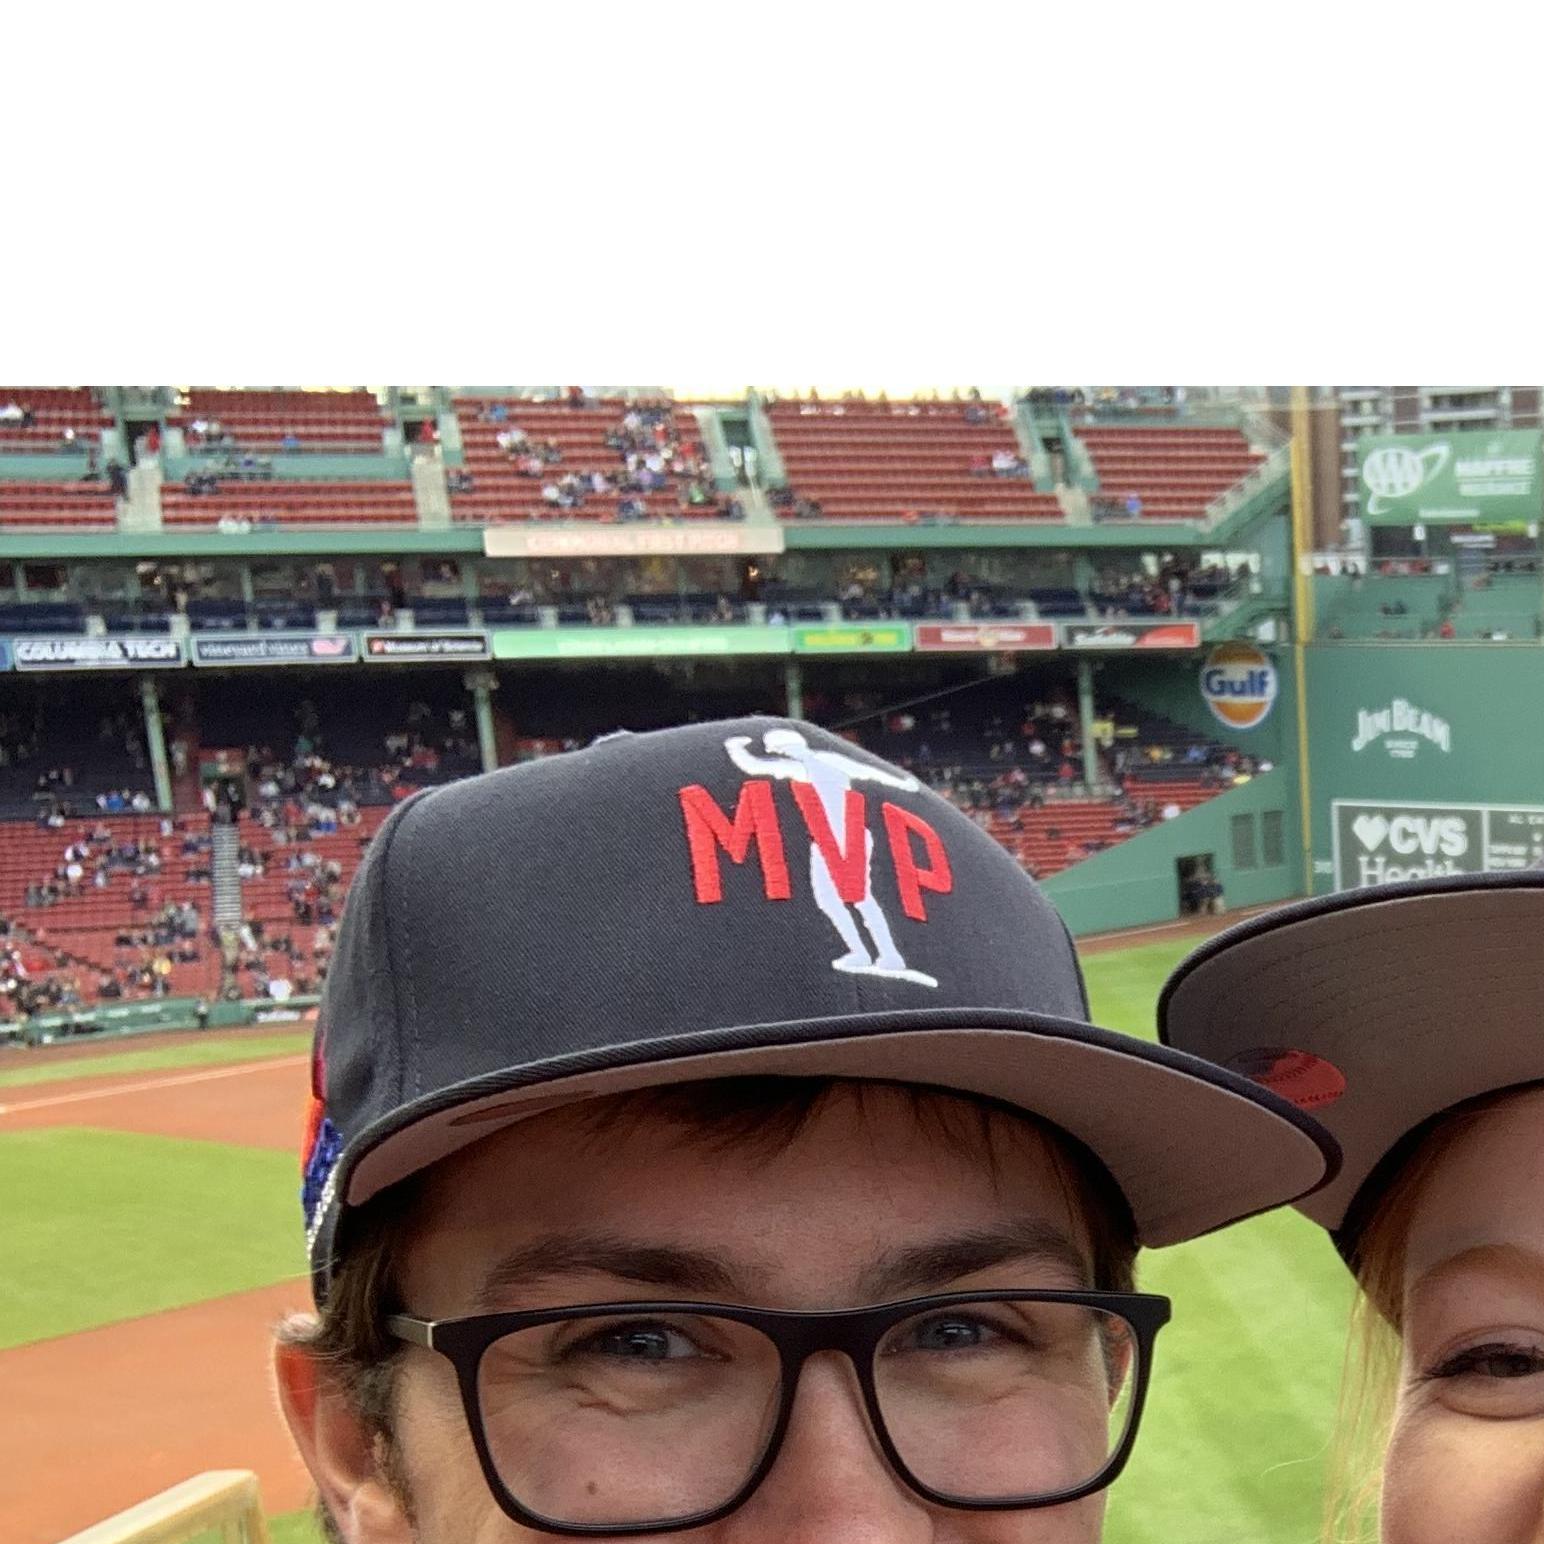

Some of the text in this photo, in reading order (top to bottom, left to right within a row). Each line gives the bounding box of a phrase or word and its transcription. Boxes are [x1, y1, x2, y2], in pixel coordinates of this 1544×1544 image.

[1206, 669, 1270, 695] Gulf
[678, 779, 953, 922] MVP
[1388, 815, 1468, 857] CVS
